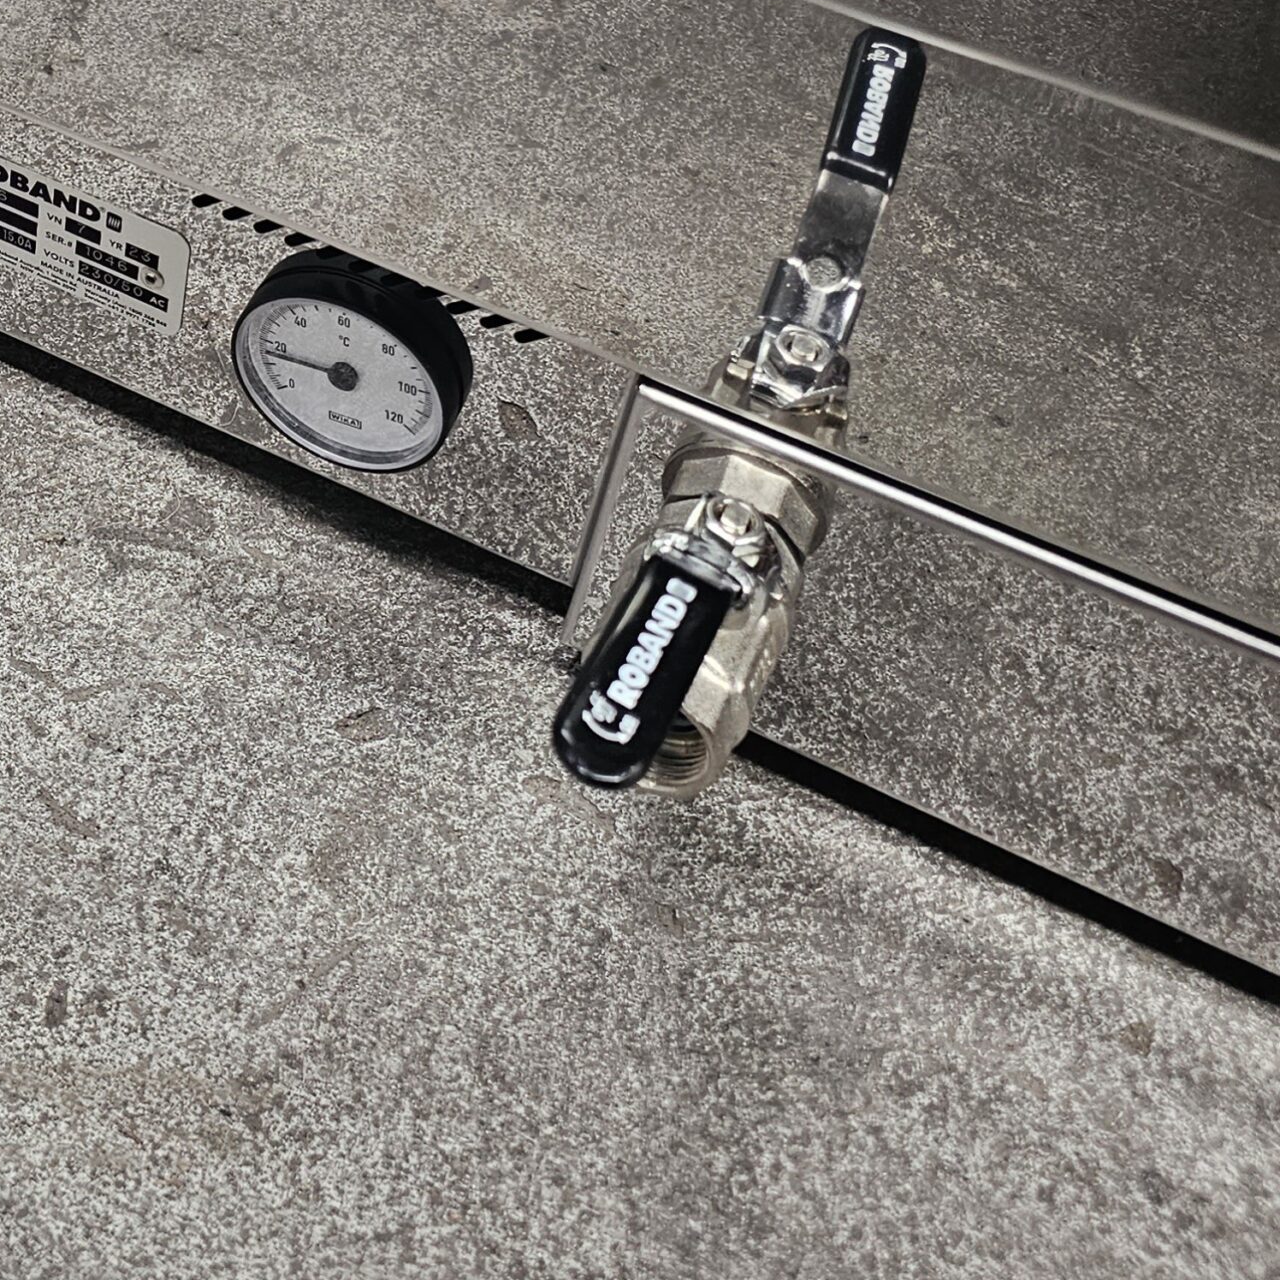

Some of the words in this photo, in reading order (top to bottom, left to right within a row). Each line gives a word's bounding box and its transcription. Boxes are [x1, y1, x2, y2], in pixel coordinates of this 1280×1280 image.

[46, 212, 63, 225] VN
[108, 239, 124, 251] YR
[85, 246, 128, 272] 1046
[40, 261, 65, 276] MADE
[65, 271, 75, 280] IN
[76, 277, 121, 300] AUSTRALIA
[43, 248, 75, 269] VOLTS
[149, 296, 166, 308] AC
[294, 316, 307, 329] 40
[337, 314, 351, 329] 60
[274, 340, 288, 354] 20
[381, 344, 396, 357] 80
[288, 378, 296, 389] 0
[397, 380, 418, 397] 100
[384, 409, 404, 424] 120
[606, 593, 689, 711] ROBAND
